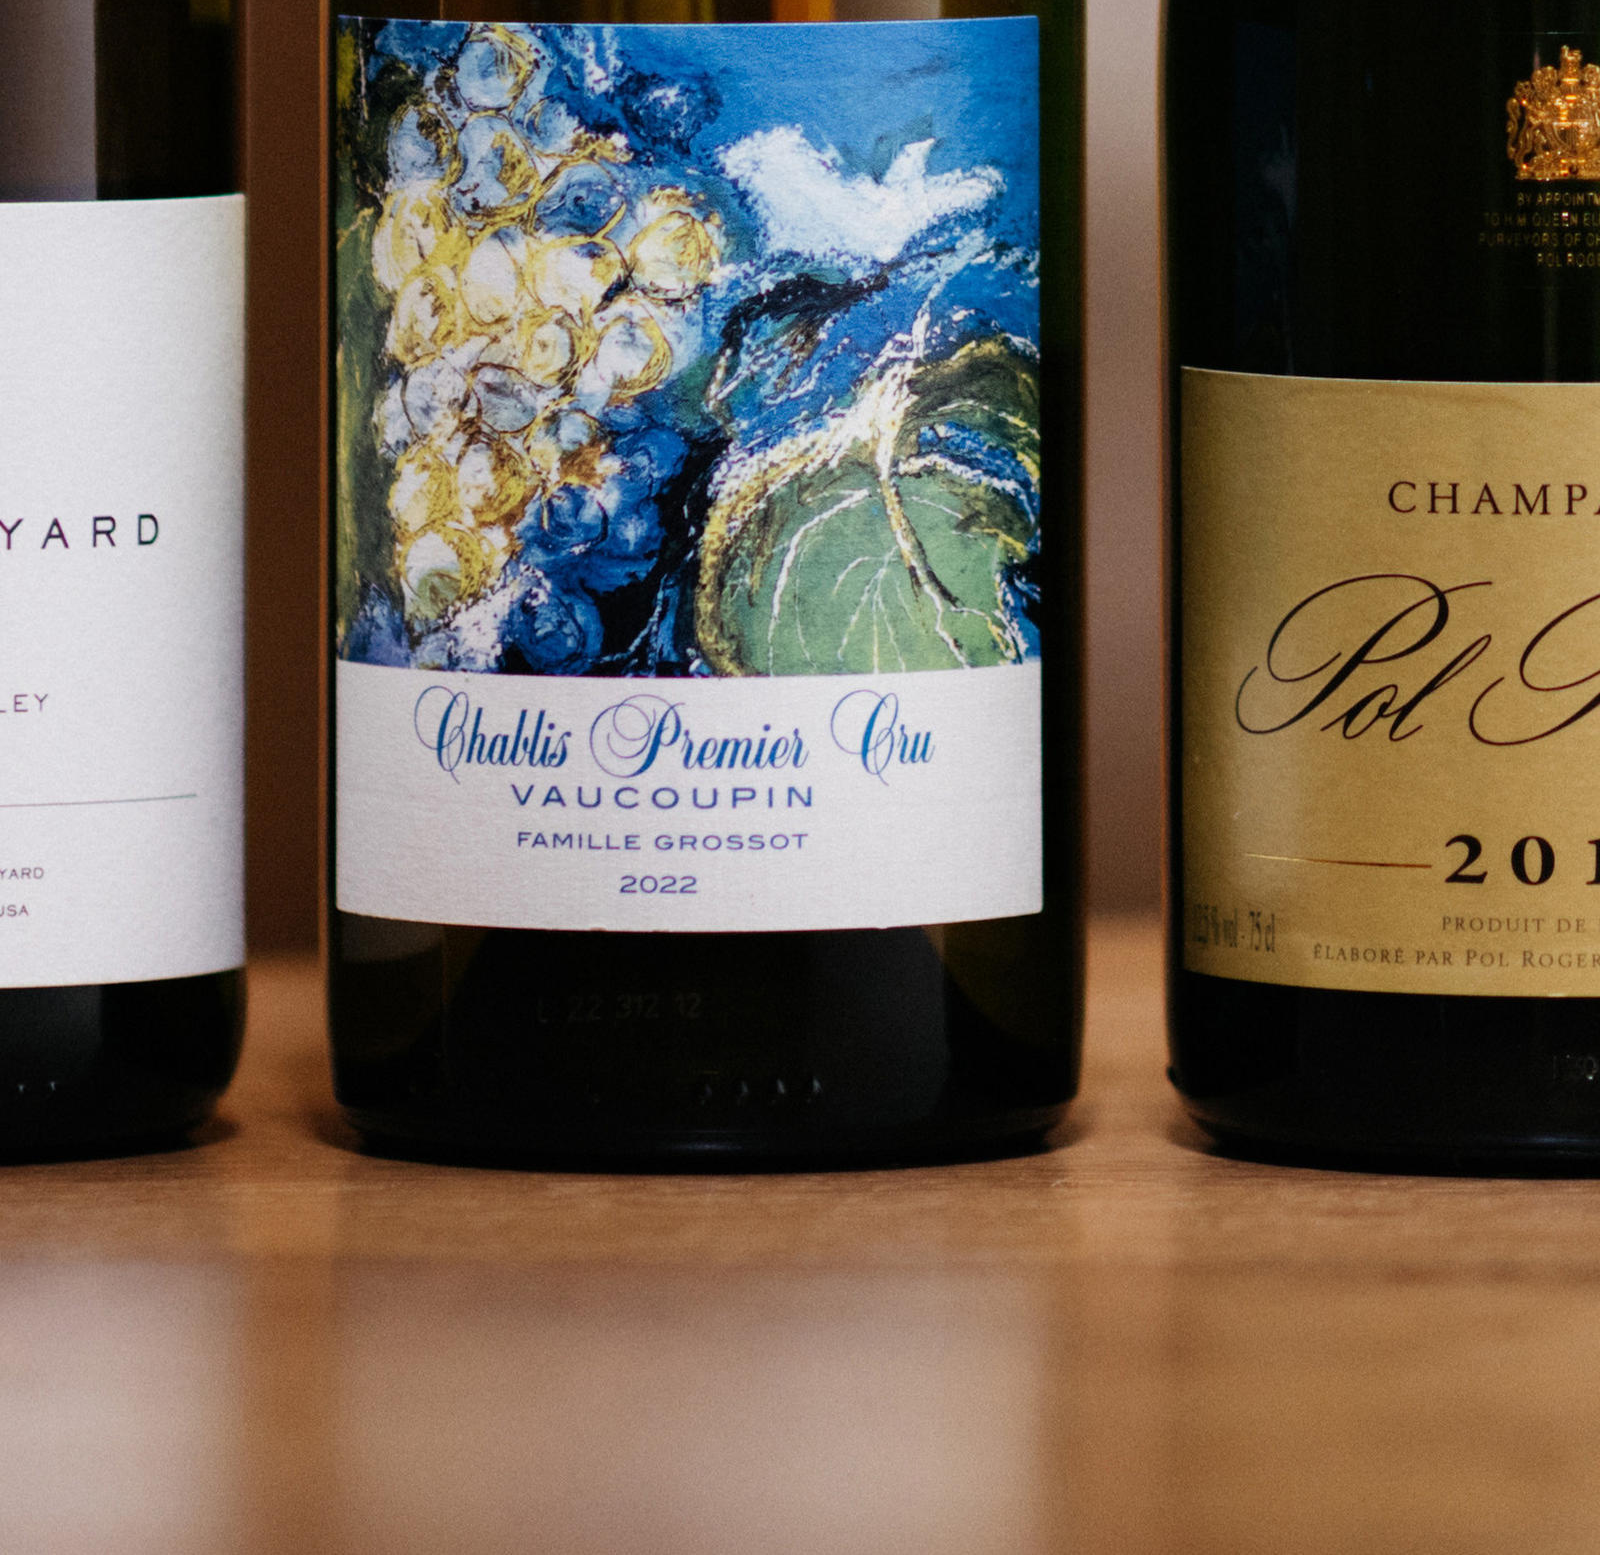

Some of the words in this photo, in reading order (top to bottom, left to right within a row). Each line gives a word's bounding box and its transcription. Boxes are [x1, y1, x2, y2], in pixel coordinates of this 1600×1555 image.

[1532, 211, 1579, 228] QUEEN
[1478, 232, 1559, 249] PURVEYORS
[1563, 232, 1583, 248] OF
[1536, 251, 1563, 268] POL
[1235, 573, 1493, 744] Pol
[413, 685, 573, 785] Chablis
[589, 693, 809, 779] Premier
[830, 688, 934, 786] Cru
[511, 784, 814, 811] VAUCOUPIN
[517, 832, 641, 851] FAMILLE
[655, 833, 809, 852] GROSSOT
[619, 875, 697, 895] 2022
[1441, 916, 1546, 934] PRODUIT
[1557, 916, 1587, 934] DE
[1415, 950, 1453, 966] PAR
